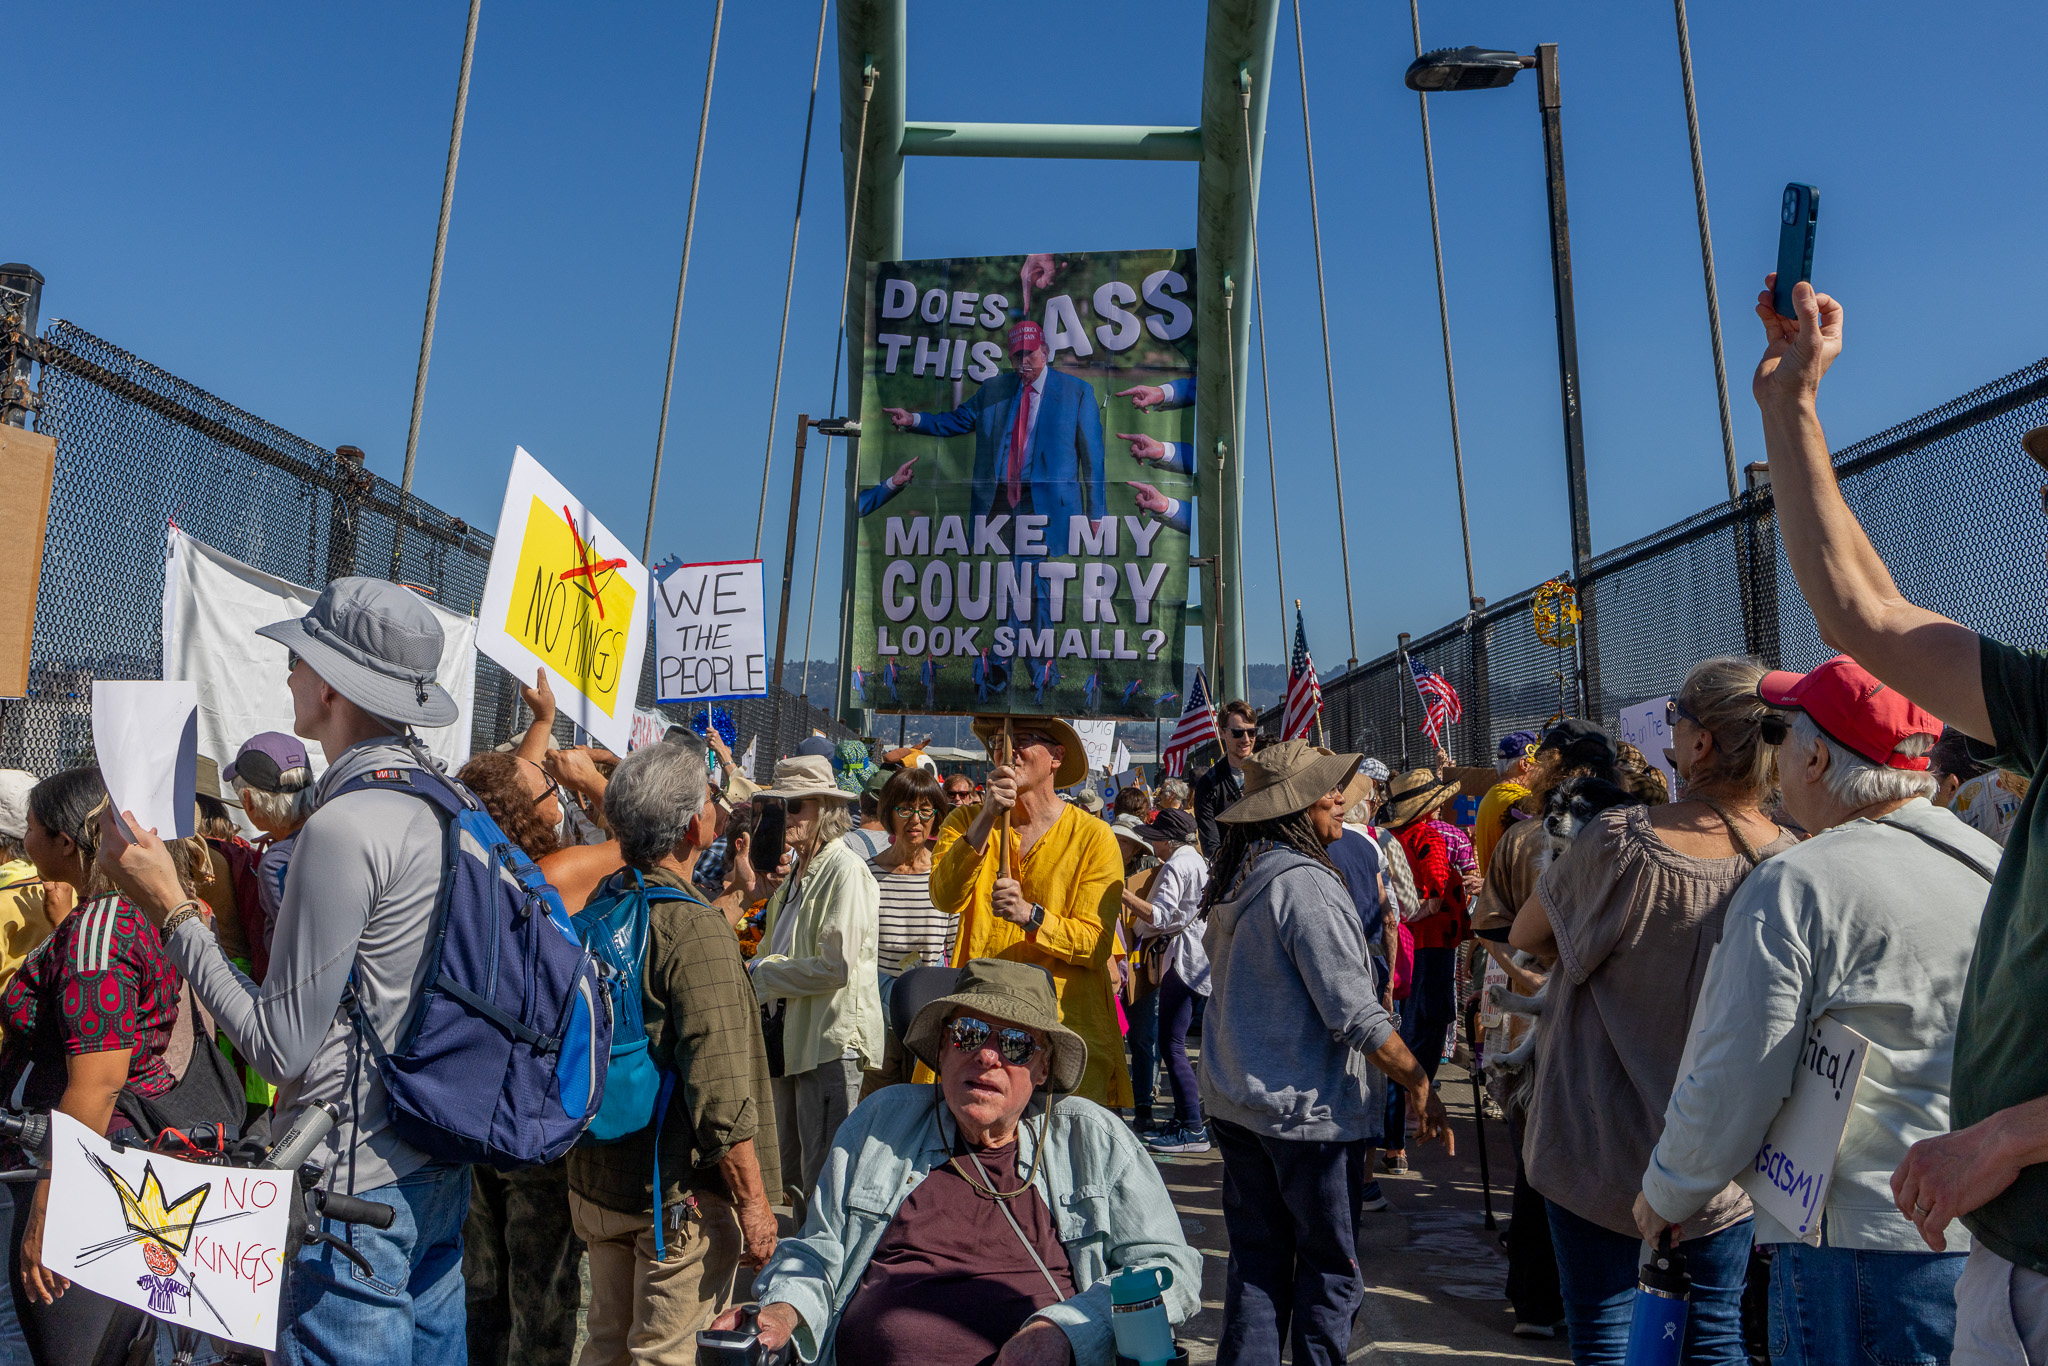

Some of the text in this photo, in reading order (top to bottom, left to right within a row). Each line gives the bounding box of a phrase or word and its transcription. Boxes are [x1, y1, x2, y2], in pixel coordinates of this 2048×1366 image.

[882, 278, 1009, 329] DOES
[1043, 269, 1193, 363] ASS
[878, 333, 1002, 382] THIS
[885, 514, 1162, 557] MAKE MY
[660, 571, 746, 618] WE
[882, 559, 1167, 624] COUNTRY
[525, 565, 624, 694] NO KINGS
[676, 624, 732, 651] THE
[878, 625, 1167, 661] LOOK SMALL?
[661, 653, 765, 698] PEOPLE
[224, 1177, 278, 1209] NO
[194, 1235, 277, 1293] KINGS
